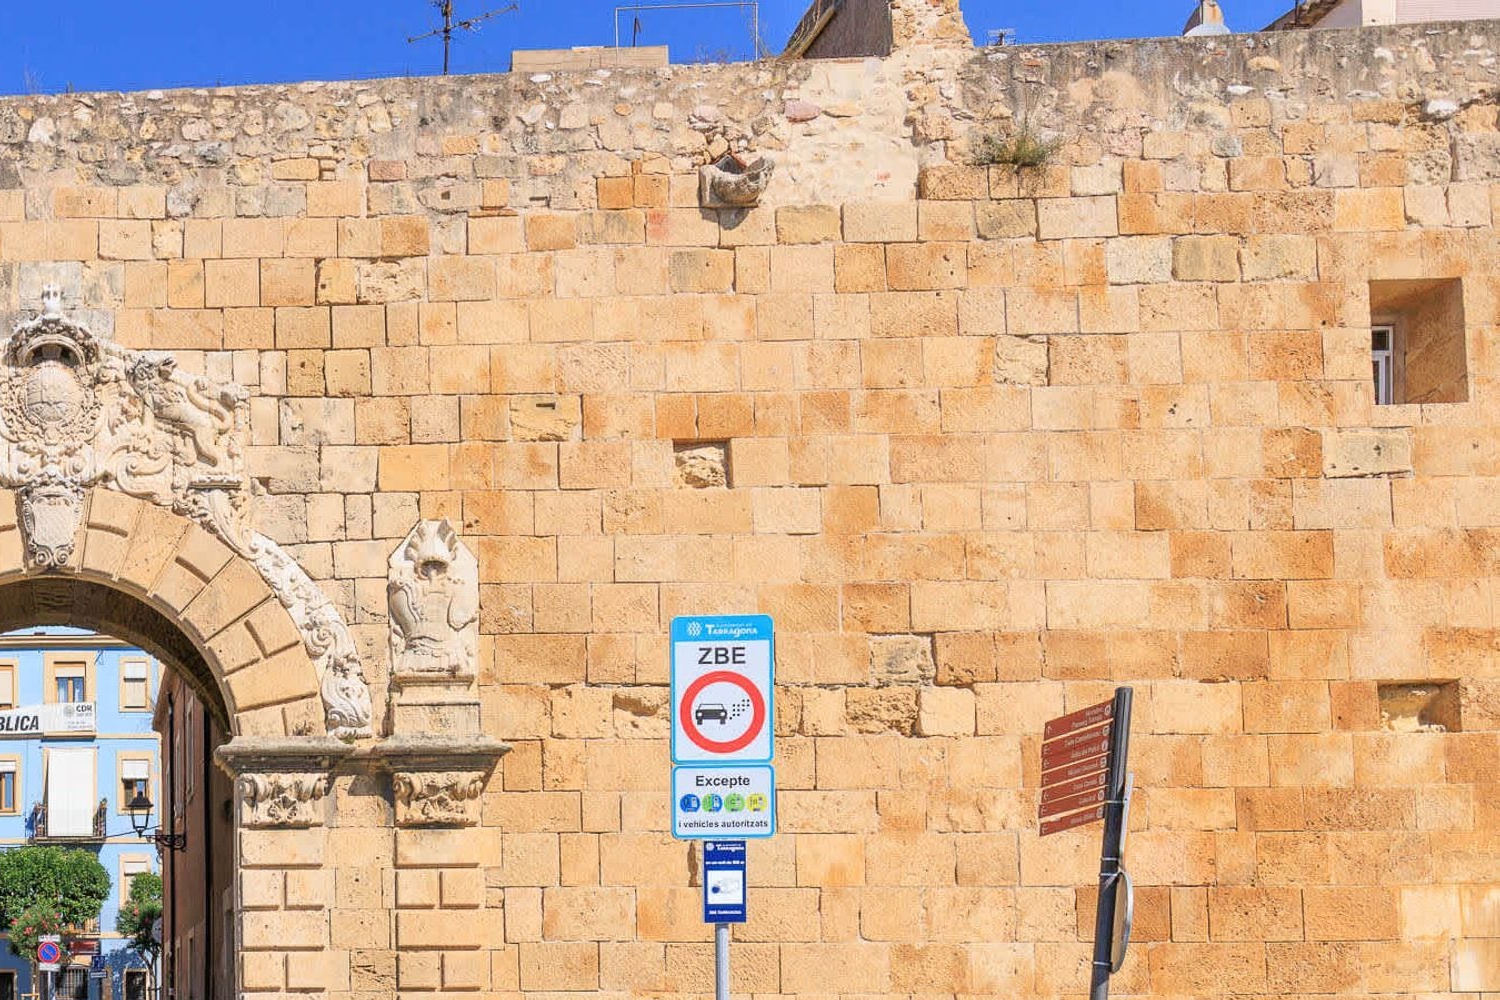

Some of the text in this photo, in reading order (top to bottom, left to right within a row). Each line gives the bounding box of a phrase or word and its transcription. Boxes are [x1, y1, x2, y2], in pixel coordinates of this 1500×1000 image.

[698, 646, 746, 665] ZBE
[695, 775, 750, 789] Excepte
[683, 820, 719, 828] vehicles
[721, 819, 768, 828] autoritzats
